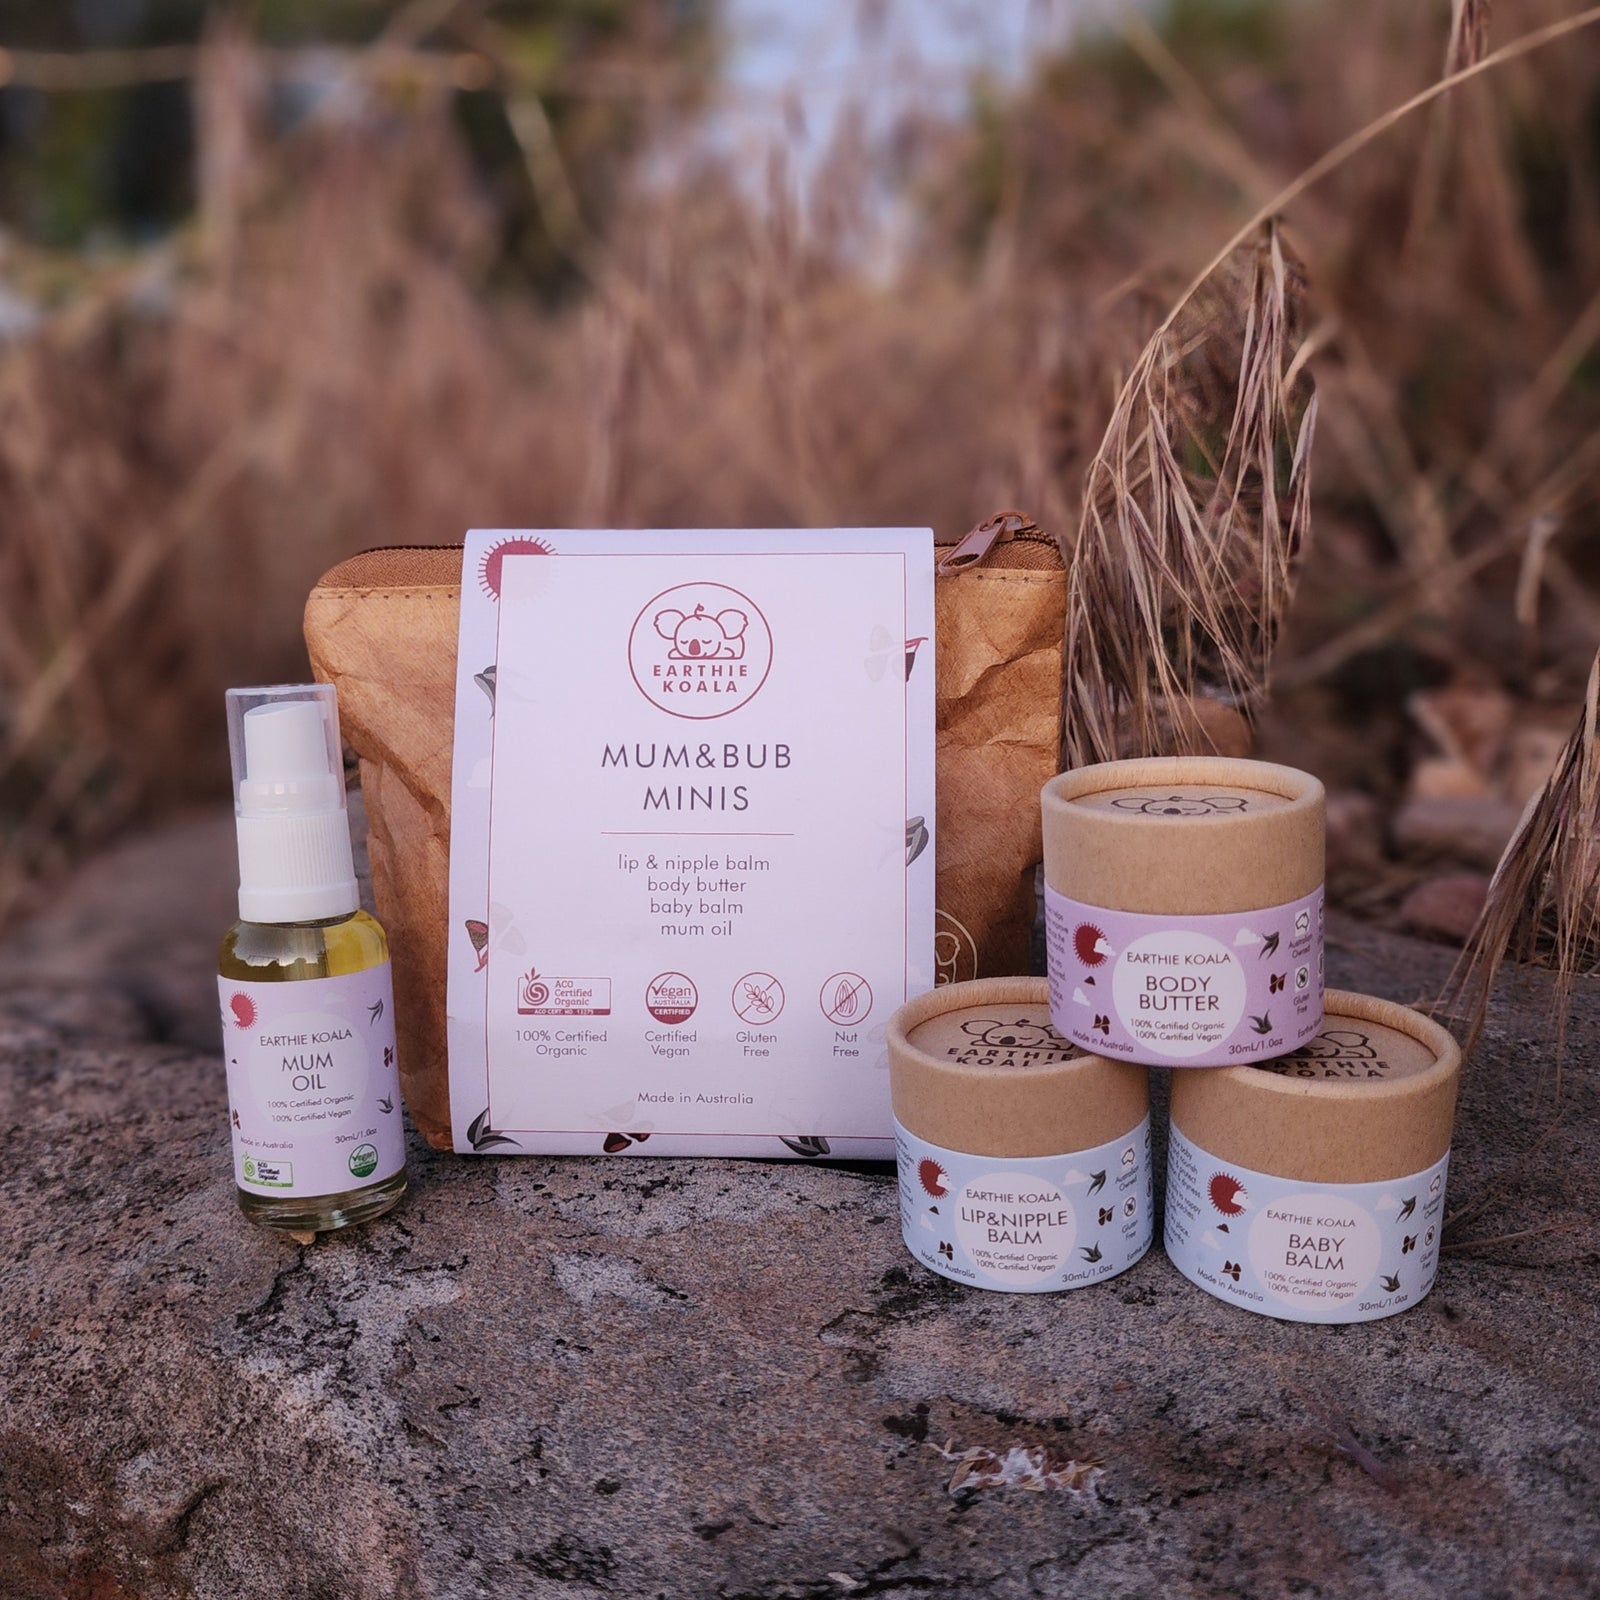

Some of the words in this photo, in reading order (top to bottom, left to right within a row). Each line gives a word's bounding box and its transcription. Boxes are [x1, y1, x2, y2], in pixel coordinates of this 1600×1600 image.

[652, 664, 748, 677] EARTHIE
[662, 680, 738, 693] KOALA
[601, 743, 792, 769] MUM&BUB
[643, 785, 750, 811] MINIS
[617, 853, 639, 874] lip
[645, 856, 659, 871] &
[665, 854, 719, 874] nipple
[726, 854, 770, 871] balm
[647, 876, 690, 895] body
[696, 877, 747, 893] butter
[650, 898, 693, 917] baby
[699, 898, 744, 915] balm
[660, 922, 705, 936] mum
[711, 920, 733, 936] oil
[1126, 951, 1179, 966] EARTHIE
[1184, 953, 1231, 966] KOALA
[554, 980, 574, 988] ACO
[652, 981, 691, 1000] Vegan
[1145, 976, 1212, 993] BODY
[554, 988, 593, 997] Certified
[554, 998, 590, 1007] Organic
[1139, 994, 1220, 1012] BUTTER
[1130, 1018, 1152, 1029] 100%
[1154, 1020, 1189, 1031] Certified
[1192, 1021, 1225, 1033] Organic
[260, 1034, 308, 1046] EARTHIE
[312, 1028, 352, 1043] KOALA
[516, 1030, 551, 1042] 100%
[555, 1030, 607, 1042] Certified
[644, 1030, 697, 1042] Certified
[735, 1031, 778, 1044] Gluten
[834, 1031, 858, 1044] Nut
[1072, 1028, 1090, 1044] Made
[1092, 1038, 1098, 1047] in
[1099, 1039, 1134, 1053] Australia
[1135, 1030, 1157, 1040] 100%
[1159, 1031, 1194, 1041] Certified
[1196, 1032, 1222, 1044] Vegan
[536, 1044, 588, 1058] Organic
[650, 1044, 690, 1058] Vegan
[743, 1045, 770, 1058] Free
[832, 1046, 860, 1058] Free
[947, 1048, 1074, 1060] EARTHIE
[1228, 1036, 1284, 1056] 30mL/1.0oz
[281, 1052, 334, 1072] MUM
[292, 1074, 326, 1092] OIL
[268, 1100, 288, 1108] 100%
[289, 1098, 322, 1108] Certified
[324, 1093, 355, 1106] Organic
[637, 1091, 675, 1104] Made
[678, 1092, 691, 1104] in
[695, 1092, 754, 1105] Australia
[272, 1114, 292, 1122] 100%
[294, 1112, 326, 1122] Certified
[328, 1109, 352, 1121] Vegan
[334, 1128, 378, 1144] 30mL/1.0oz
[262, 1140, 294, 1149] Australia
[966, 1188, 1014, 1204] EARTHIE
[1018, 1192, 1062, 1203] KOALA
[961, 1207, 1068, 1228] LIP&NIPPLE
[1266, 1209, 1314, 1227] EARTHIE
[1316, 1215, 1356, 1228] KOALA
[988, 1228, 1042, 1245] BALM
[1288, 1234, 1346, 1252] BABY
[971, 1248, 992, 1260] 100%
[993, 1250, 1026, 1262] Certified
[1027, 1252, 1059, 1264] Organic
[1285, 1251, 1344, 1270] BALM
[938, 1261, 944, 1270] in
[944, 1262, 976, 1280] Australia
[976, 1258, 996, 1269] 100%
[998, 1261, 1030, 1272] Certified
[1031, 1262, 1056, 1273] Vegan
[1062, 1262, 1114, 1283] 30mL/1.0oz
[1197, 1268, 1216, 1286] Made
[1218, 1279, 1226, 1289] in
[1227, 1282, 1264, 1302] Australia
[1264, 1270, 1286, 1282] 100%
[1288, 1272, 1323, 1287] Certified
[1325, 1278, 1358, 1290] Organic
[1268, 1282, 1290, 1293] 100%
[1292, 1284, 1328, 1298] Certified
[1328, 1289, 1354, 1300] Vegan
[1358, 1294, 1410, 1312] 30mL/1.0oz
